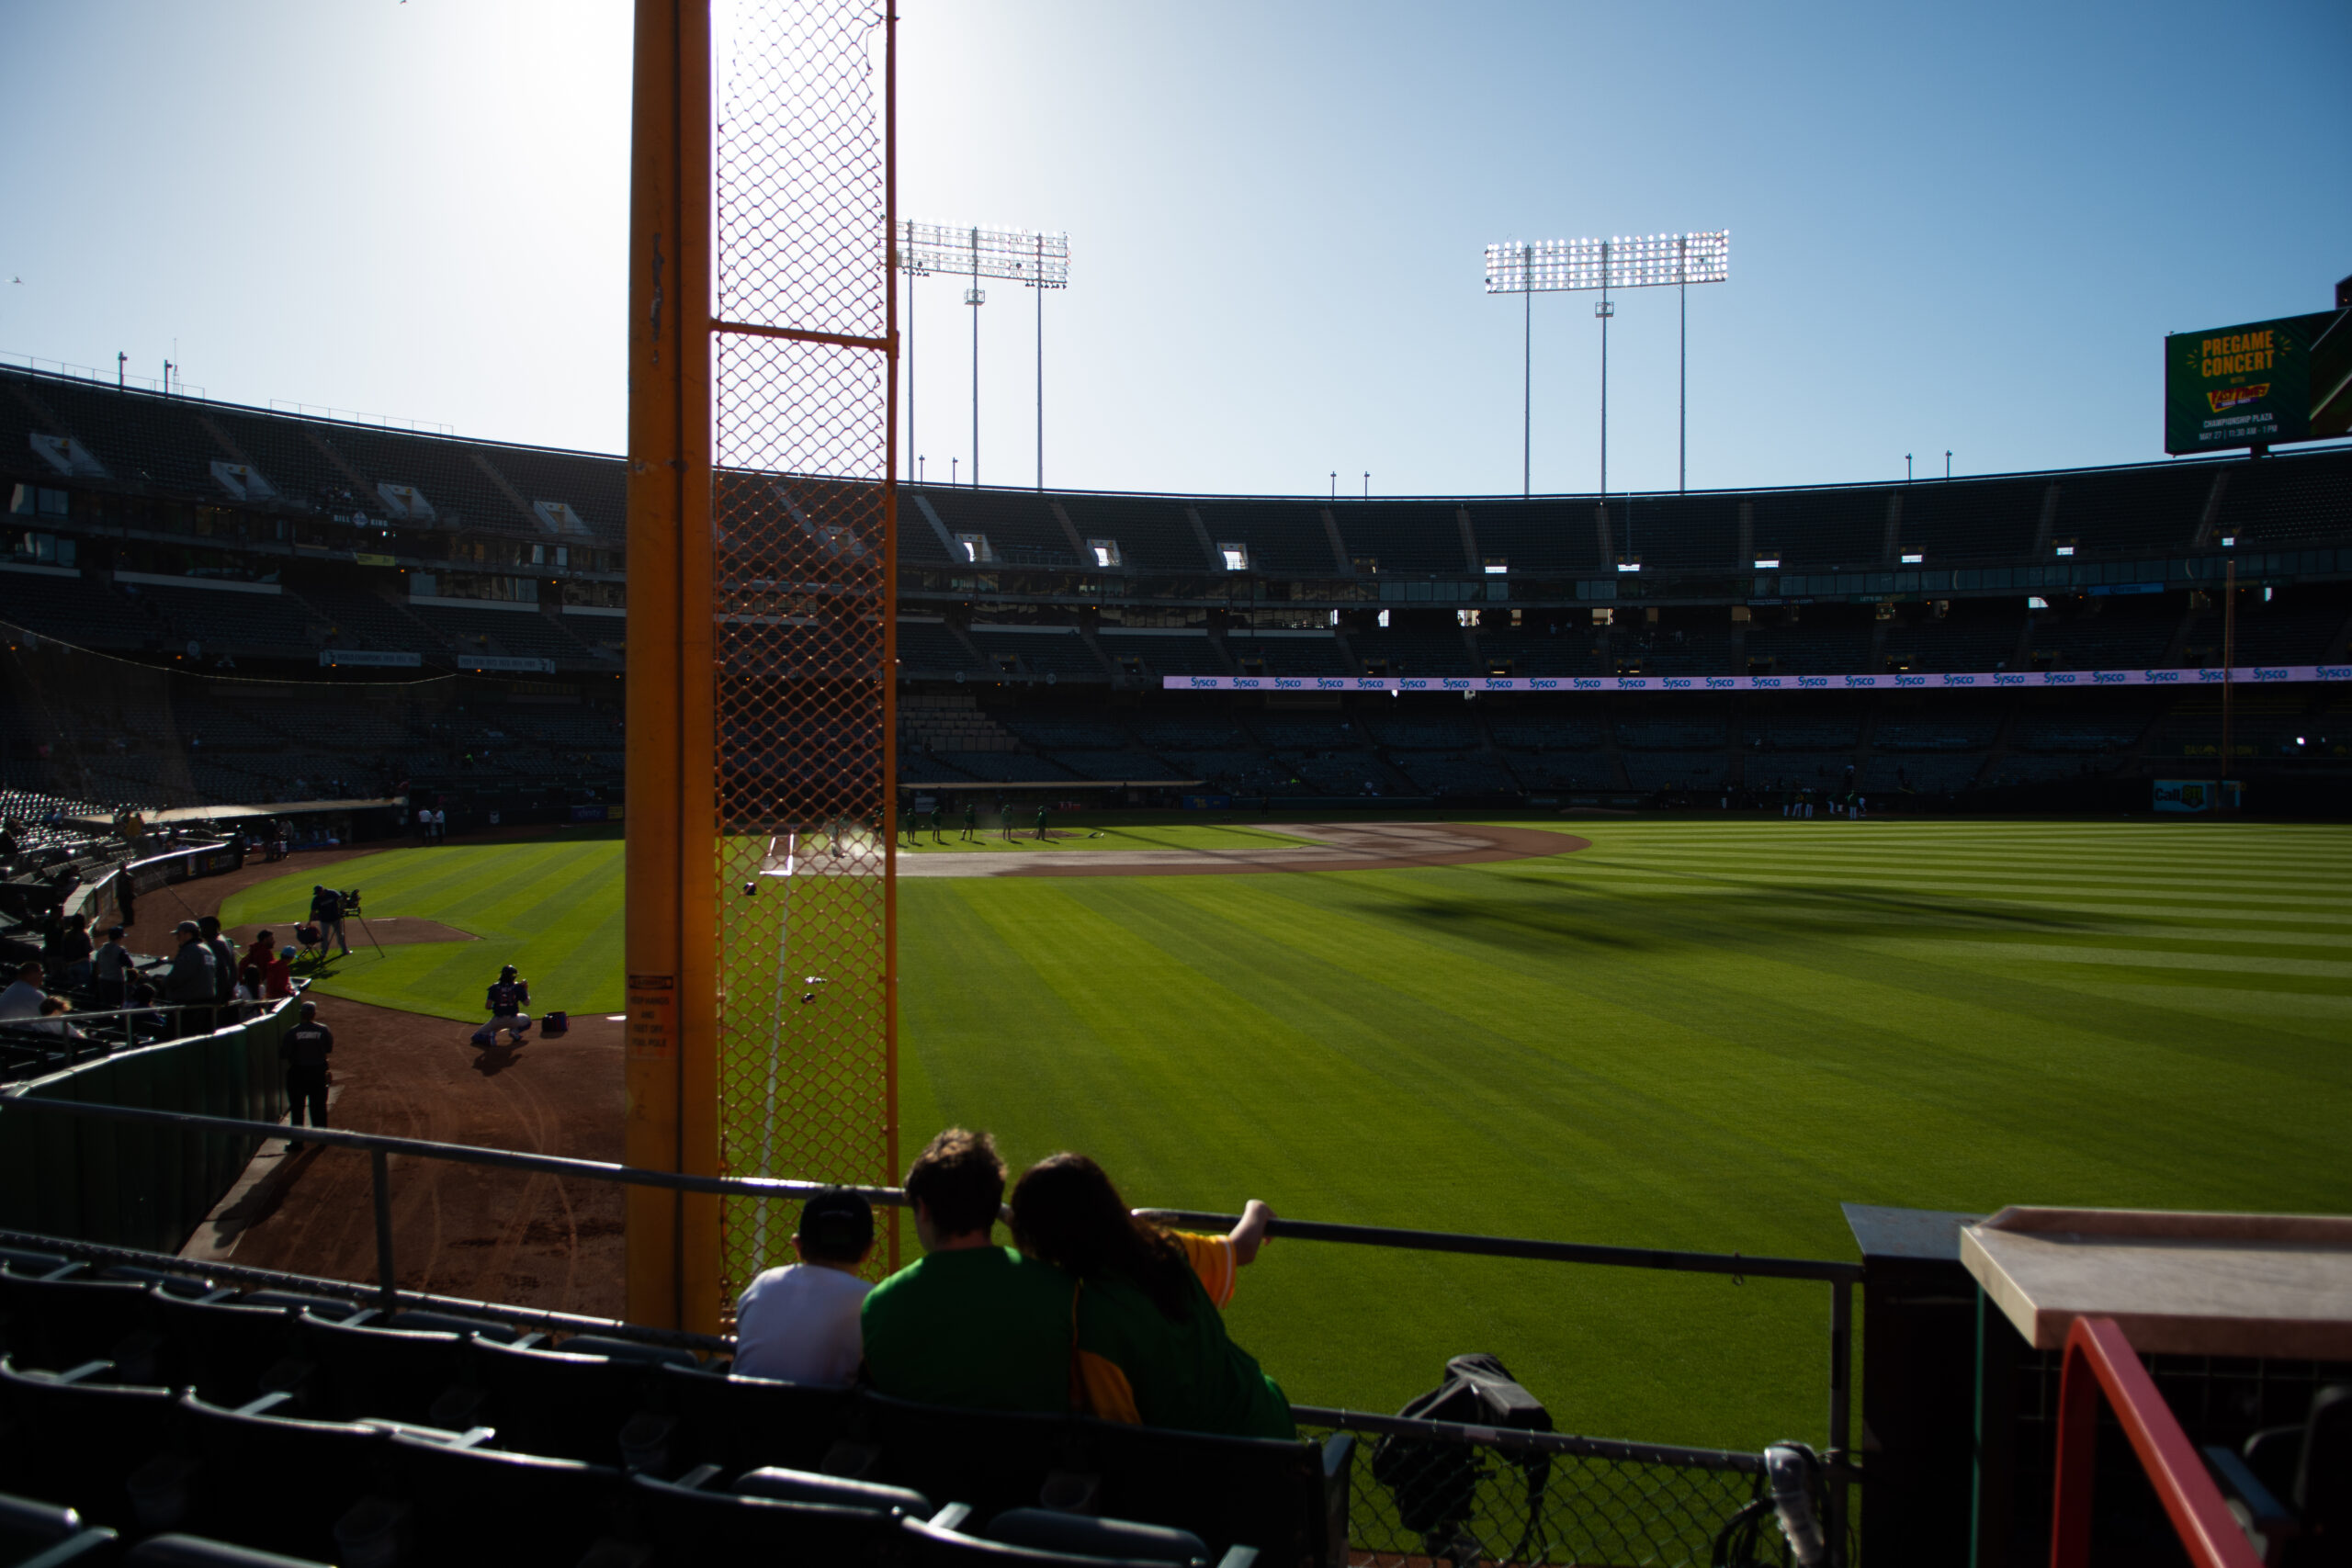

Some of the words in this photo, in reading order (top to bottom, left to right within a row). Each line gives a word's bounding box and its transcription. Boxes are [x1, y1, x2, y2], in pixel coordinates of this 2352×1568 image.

[2202, 331, 2275, 357] PREGAME
[2201, 349, 2275, 378] CONCERT
[2203, 415, 2251, 428] CHAMPIONSHIP
[2252, 412, 2274, 423] PLAZA
[2199, 432, 2213, 441] MAY
[2214, 430, 2222, 440] 27
[2229, 428, 2245, 438] 11:30
[2246, 426, 2257, 435] AM
[2267, 424, 2278, 434] PM
[334, 513, 351, 523] BILL
[370, 518, 389, 527] KING
[1191, 677, 1217, 689] Sysco
[1233, 677, 1260, 689] Sysco
[1275, 677, 1302, 689] Sysco
[1317, 678, 1344, 689] Sysco
[1357, 678, 1385, 690] Sysco
[1399, 678, 1427, 690] Sysco
[1442, 678, 1470, 690] Sysco
[1486, 678, 1513, 690] Sysco
[1530, 678, 1557, 689] Sysco
[1574, 678, 1601, 689] Sysco
[1618, 678, 1646, 689] Sysco
[1663, 677, 1691, 689] Sysco
[1706, 677, 1736, 689] Sysco
[1752, 677, 1781, 688] Sysco
[1798, 676, 1828, 688] Sysco
[1846, 676, 1876, 687] Sysco
[1894, 675, 1926, 687] Sysco
[1944, 674, 1974, 686] Sysco
[1994, 673, 2025, 685] Sysco
[2044, 672, 2077, 684] Sysco
[2093, 671, 2126, 683] Sysco
[2145, 670, 2179, 682] Sysco
[2253, 668, 2288, 681] Sysco
[2316, 667, 2352, 680] Sysco
[2154, 788, 2179, 801] Call
